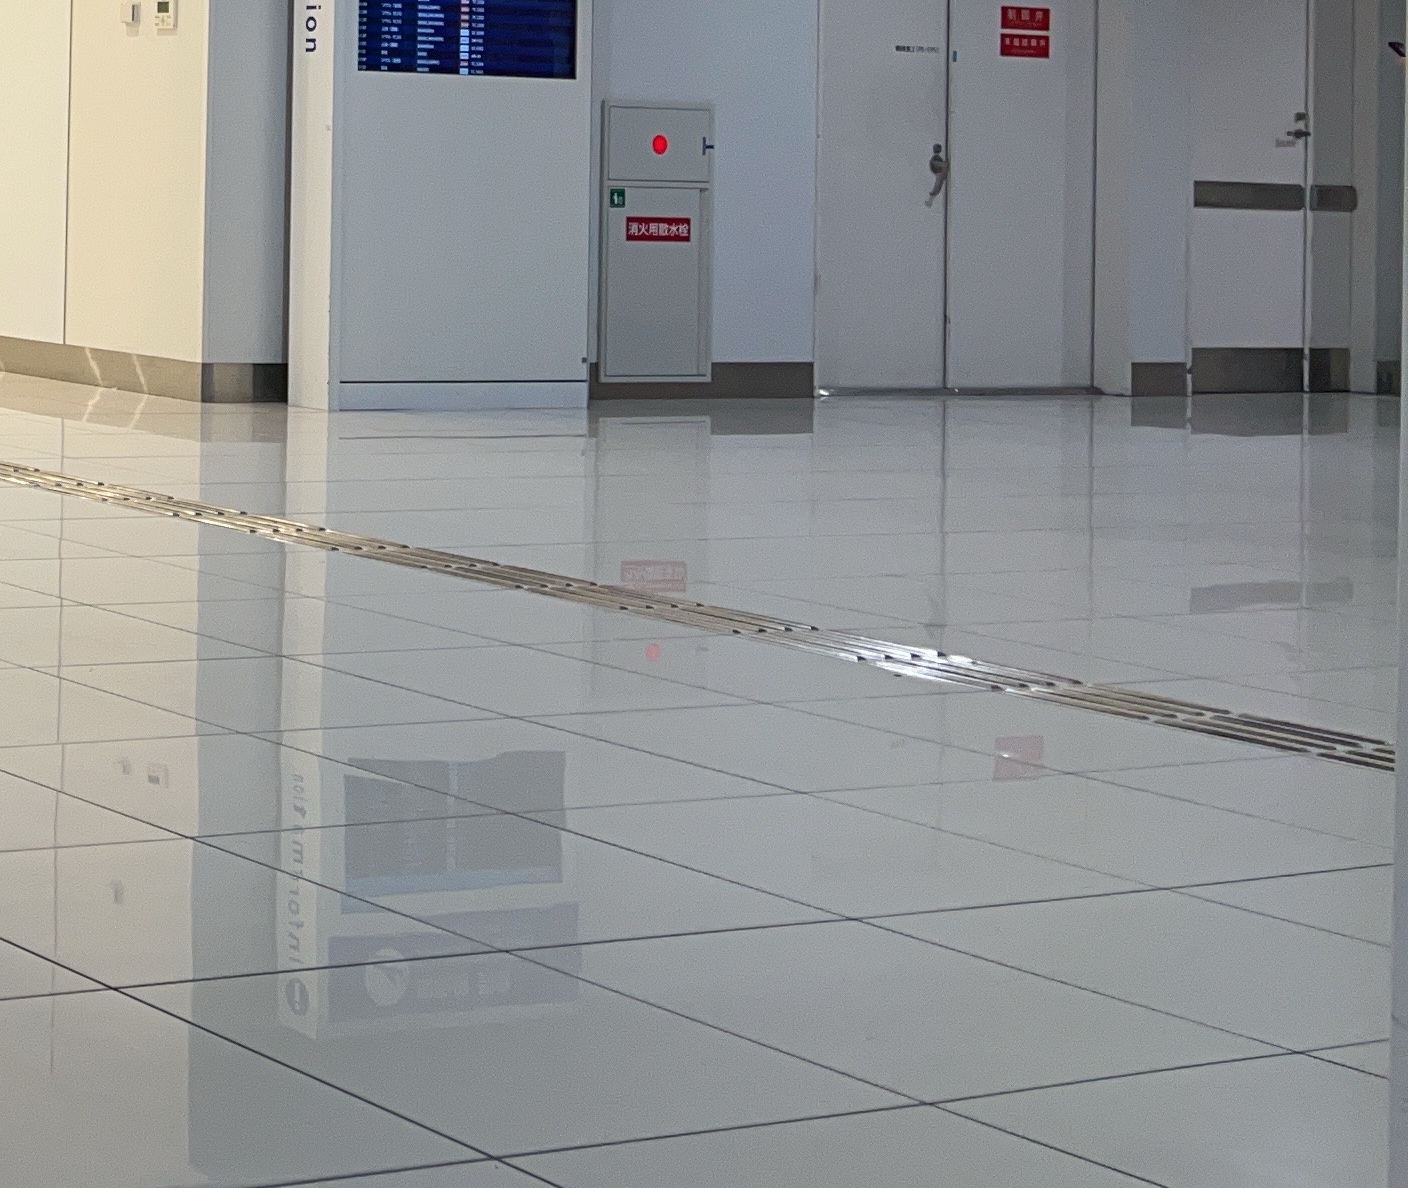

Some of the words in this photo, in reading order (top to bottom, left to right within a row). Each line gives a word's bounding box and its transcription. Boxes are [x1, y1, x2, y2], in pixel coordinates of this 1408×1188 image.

[628, 221, 689, 237] 消火用散水栓
